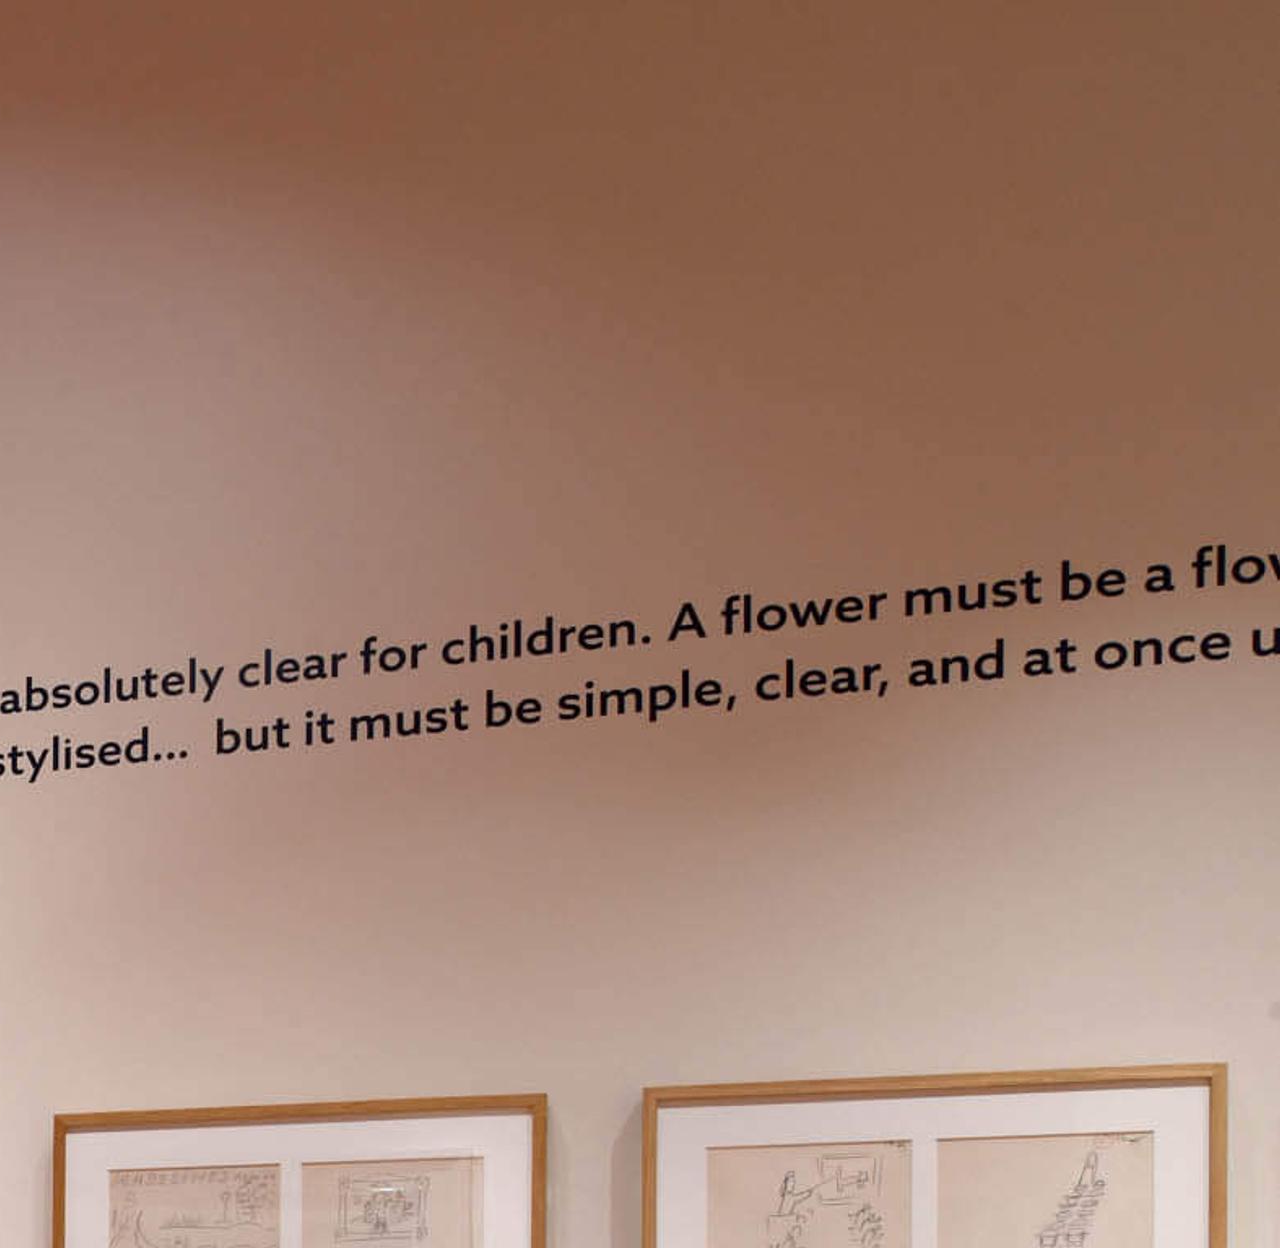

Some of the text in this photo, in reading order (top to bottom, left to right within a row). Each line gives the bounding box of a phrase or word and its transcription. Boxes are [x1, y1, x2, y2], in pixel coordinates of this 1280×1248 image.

[237, 647, 348, 689] clear
[359, 635, 428, 676] for
[441, 615, 652, 666] children.
[667, 601, 708, 642] A
[720, 592, 888, 636] flower
[904, 569, 1043, 617] must
[1060, 559, 1127, 602] be
[1143, 564, 1176, 594] a
[215, 717, 291, 756] but
[304, 709, 336, 747] it
[349, 698, 470, 742] must
[485, 689, 543, 729] be
[557, 668, 737, 724] simple,
[754, 658, 889, 702] clear,
[908, 637, 1005, 688] and
[1022, 638, 1078, 678] at
[1094, 631, 1232, 671] once
